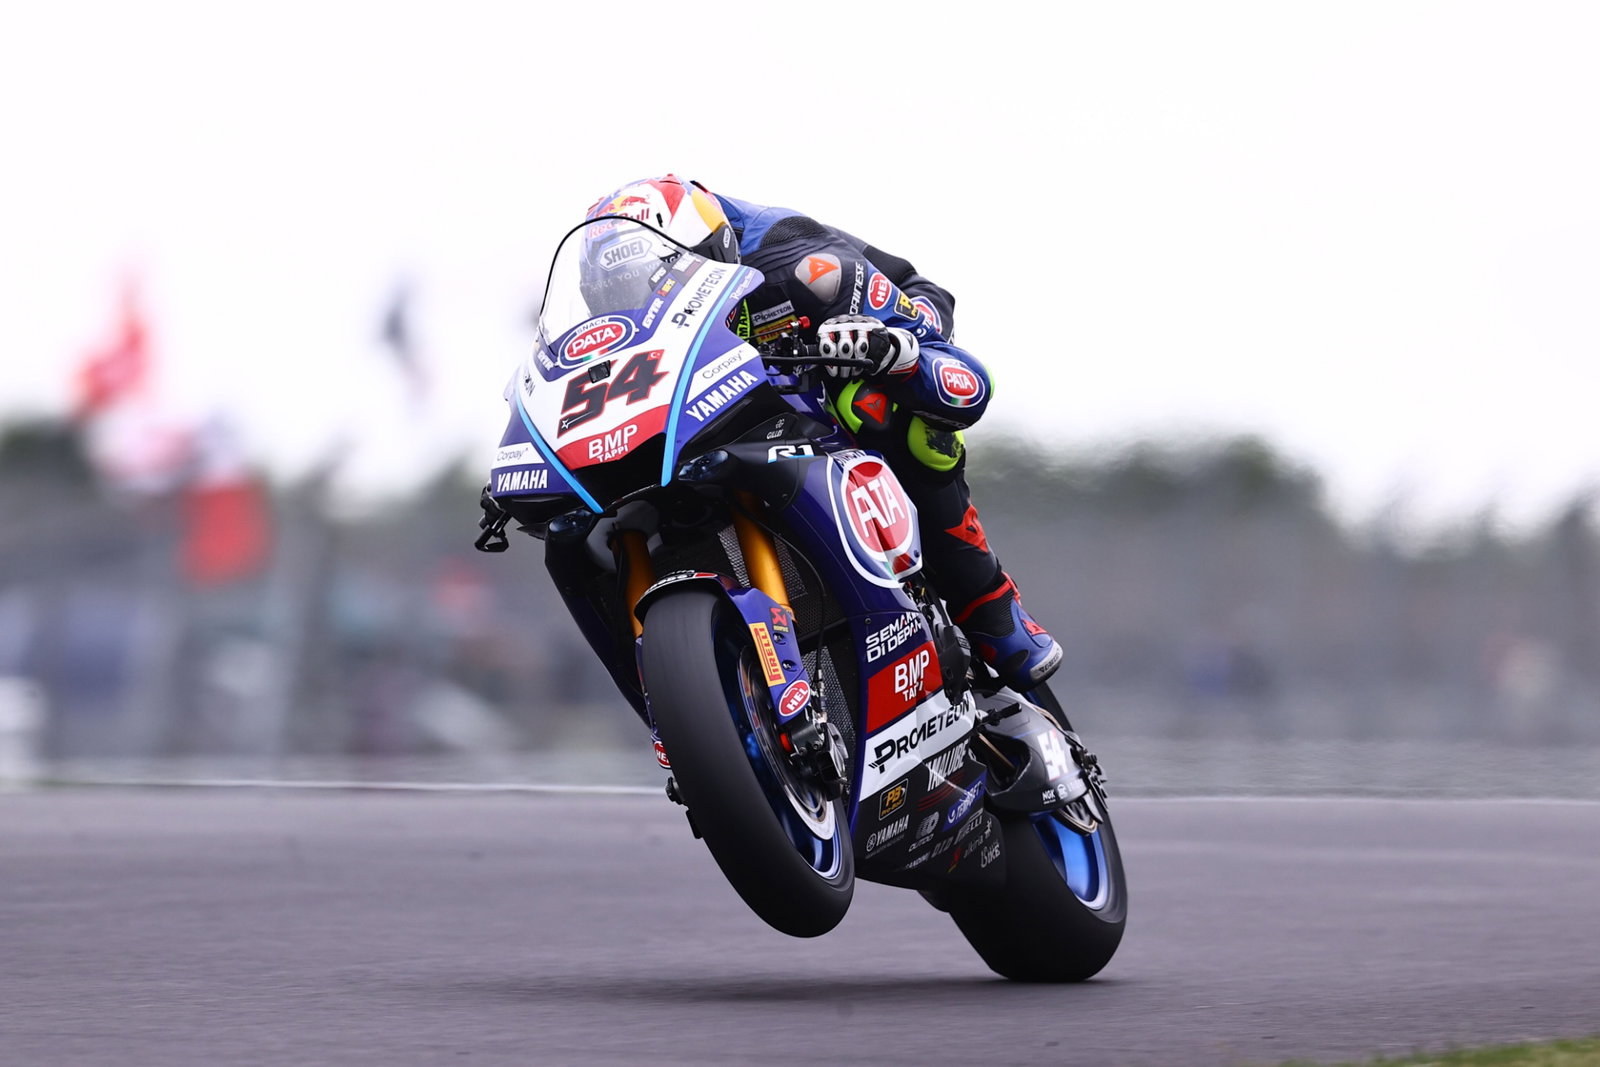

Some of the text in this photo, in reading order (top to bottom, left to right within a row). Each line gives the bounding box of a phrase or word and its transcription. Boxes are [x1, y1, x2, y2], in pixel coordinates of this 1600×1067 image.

[603, 239, 645, 266] SHOEI
[849, 261, 865, 315] DAINESE
[571, 327, 617, 355] PATA
[576, 318, 608, 336] SNACK
[702, 353, 743, 379] Corpay
[943, 371, 974, 391] PATA
[557, 349, 670, 439] 54
[685, 370, 759, 422] YAMAHA
[588, 424, 638, 460] BMP
[597, 444, 629, 463] TAPPI
[768, 444, 817, 464] R1
[497, 469, 548, 492] YAMAHA
[754, 628, 782, 681] PIRELLI
[867, 619, 922, 663] DI DEPAN
[894, 650, 930, 694] BMP
[786, 687, 808, 711] HEL
[1037, 730, 1069, 781] 54
[876, 814, 910, 847] YAMAHA
